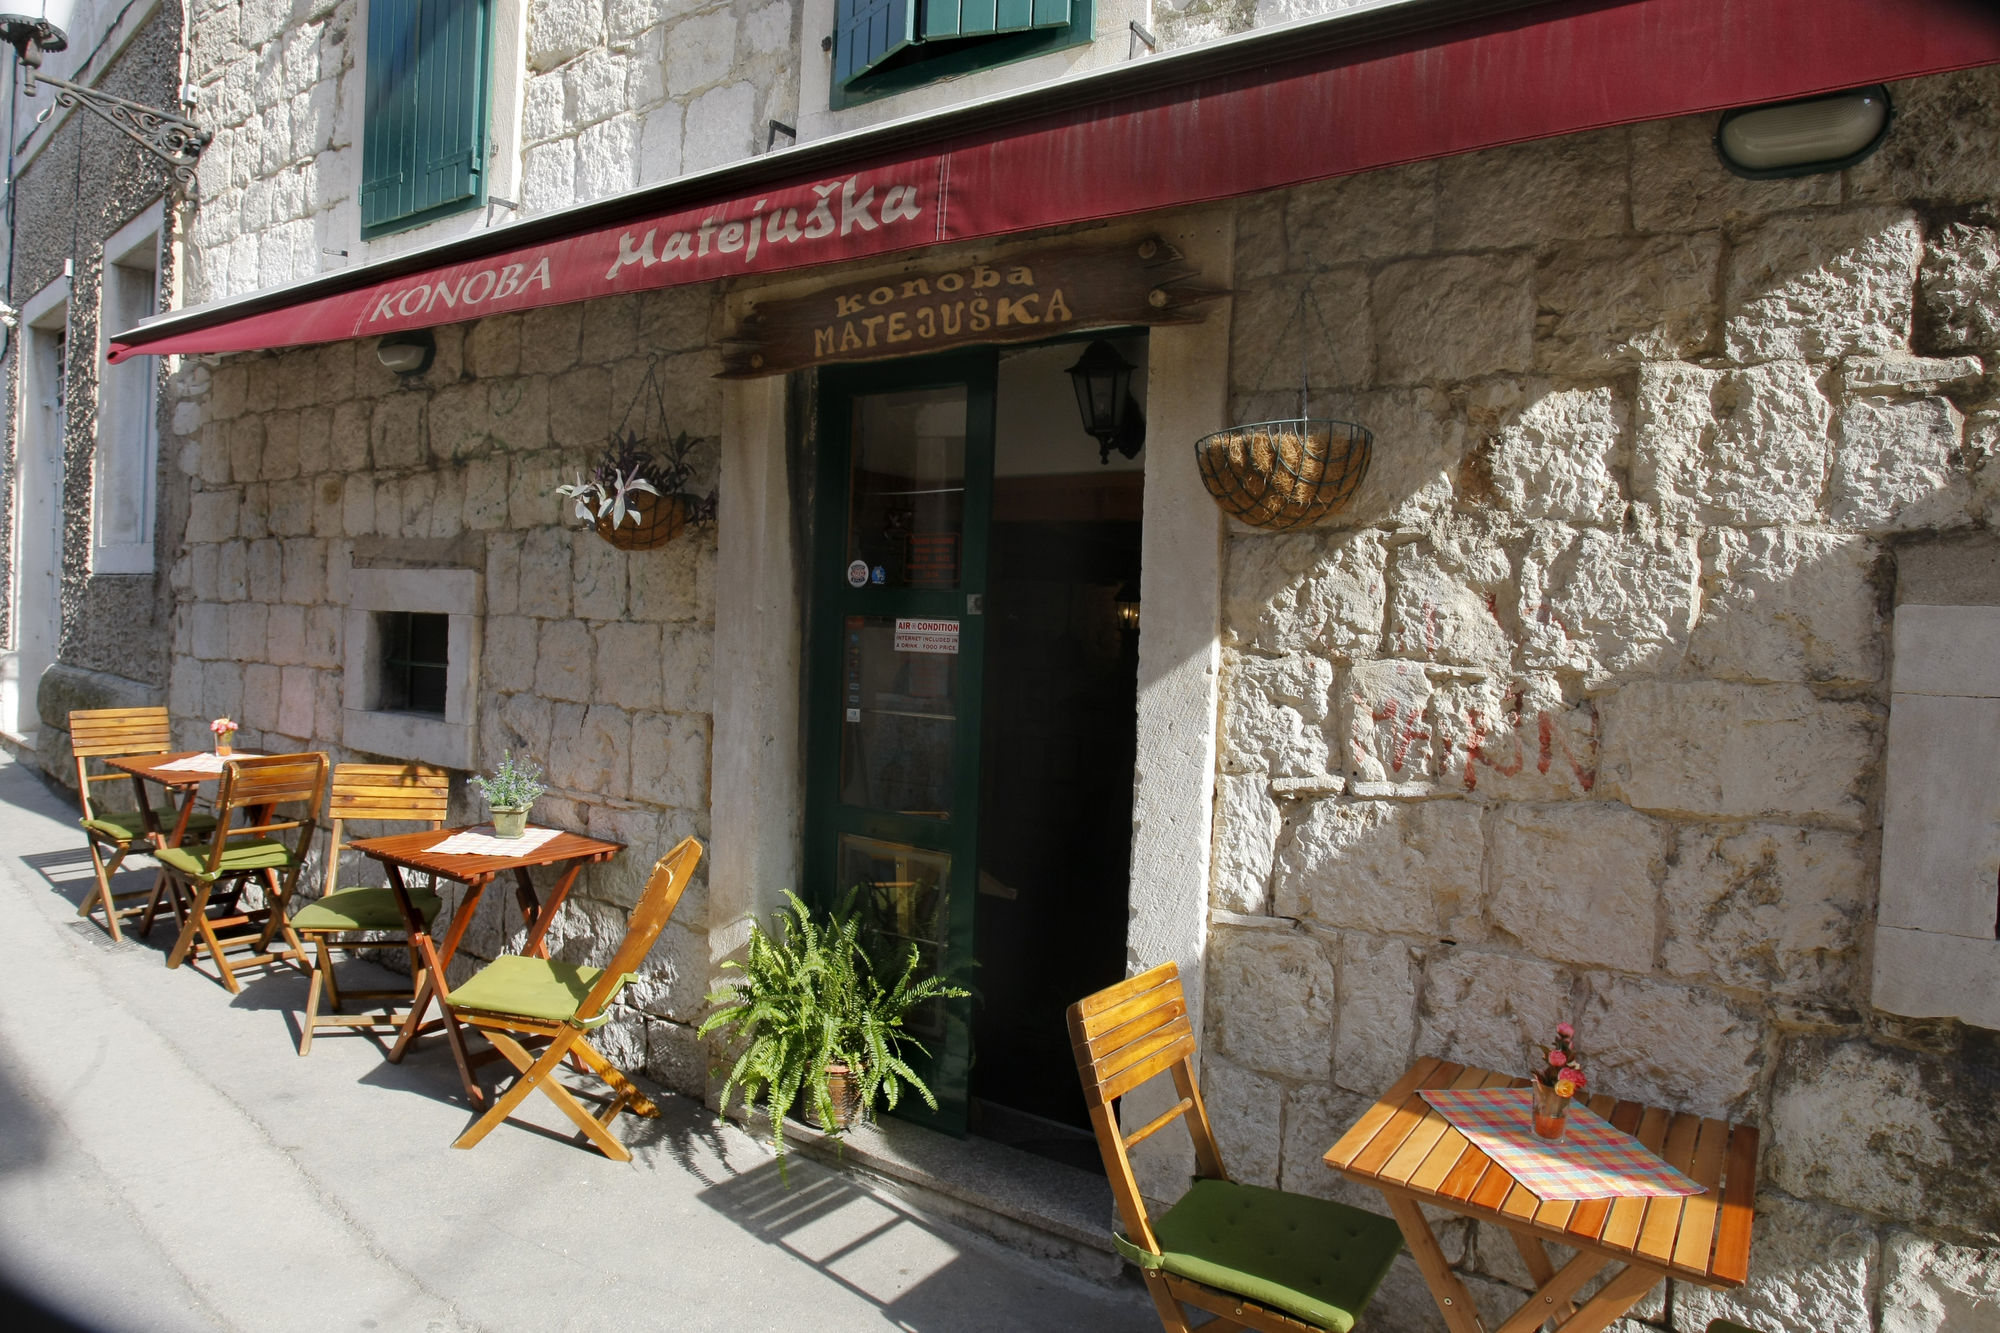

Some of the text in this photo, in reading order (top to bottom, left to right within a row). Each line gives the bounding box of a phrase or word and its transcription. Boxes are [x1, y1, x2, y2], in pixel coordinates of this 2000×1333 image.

[369, 174, 922, 323] KONOBA Matejuška
[898, 621, 959, 632] AIR CONDITION
